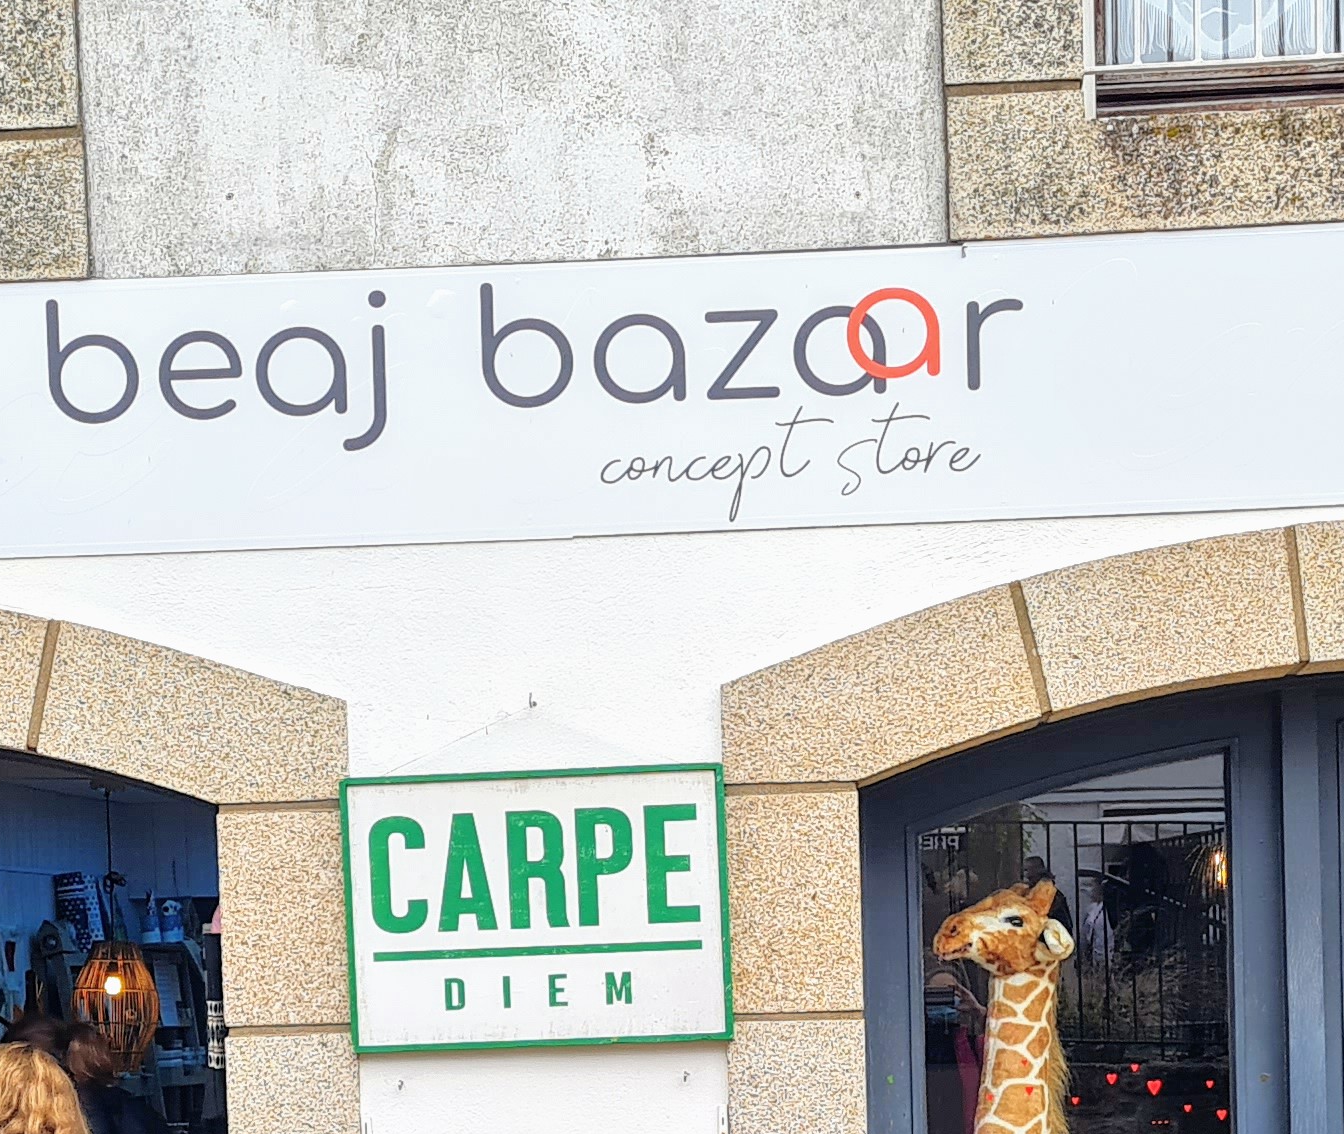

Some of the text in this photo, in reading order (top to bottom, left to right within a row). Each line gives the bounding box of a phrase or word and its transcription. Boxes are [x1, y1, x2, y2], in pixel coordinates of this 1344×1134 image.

[46, 283, 1023, 452] beaj bazaar
[600, 402, 981, 522] concept store
[368, 803, 701, 933] CARPE
[444, 971, 633, 1011] DIEM
